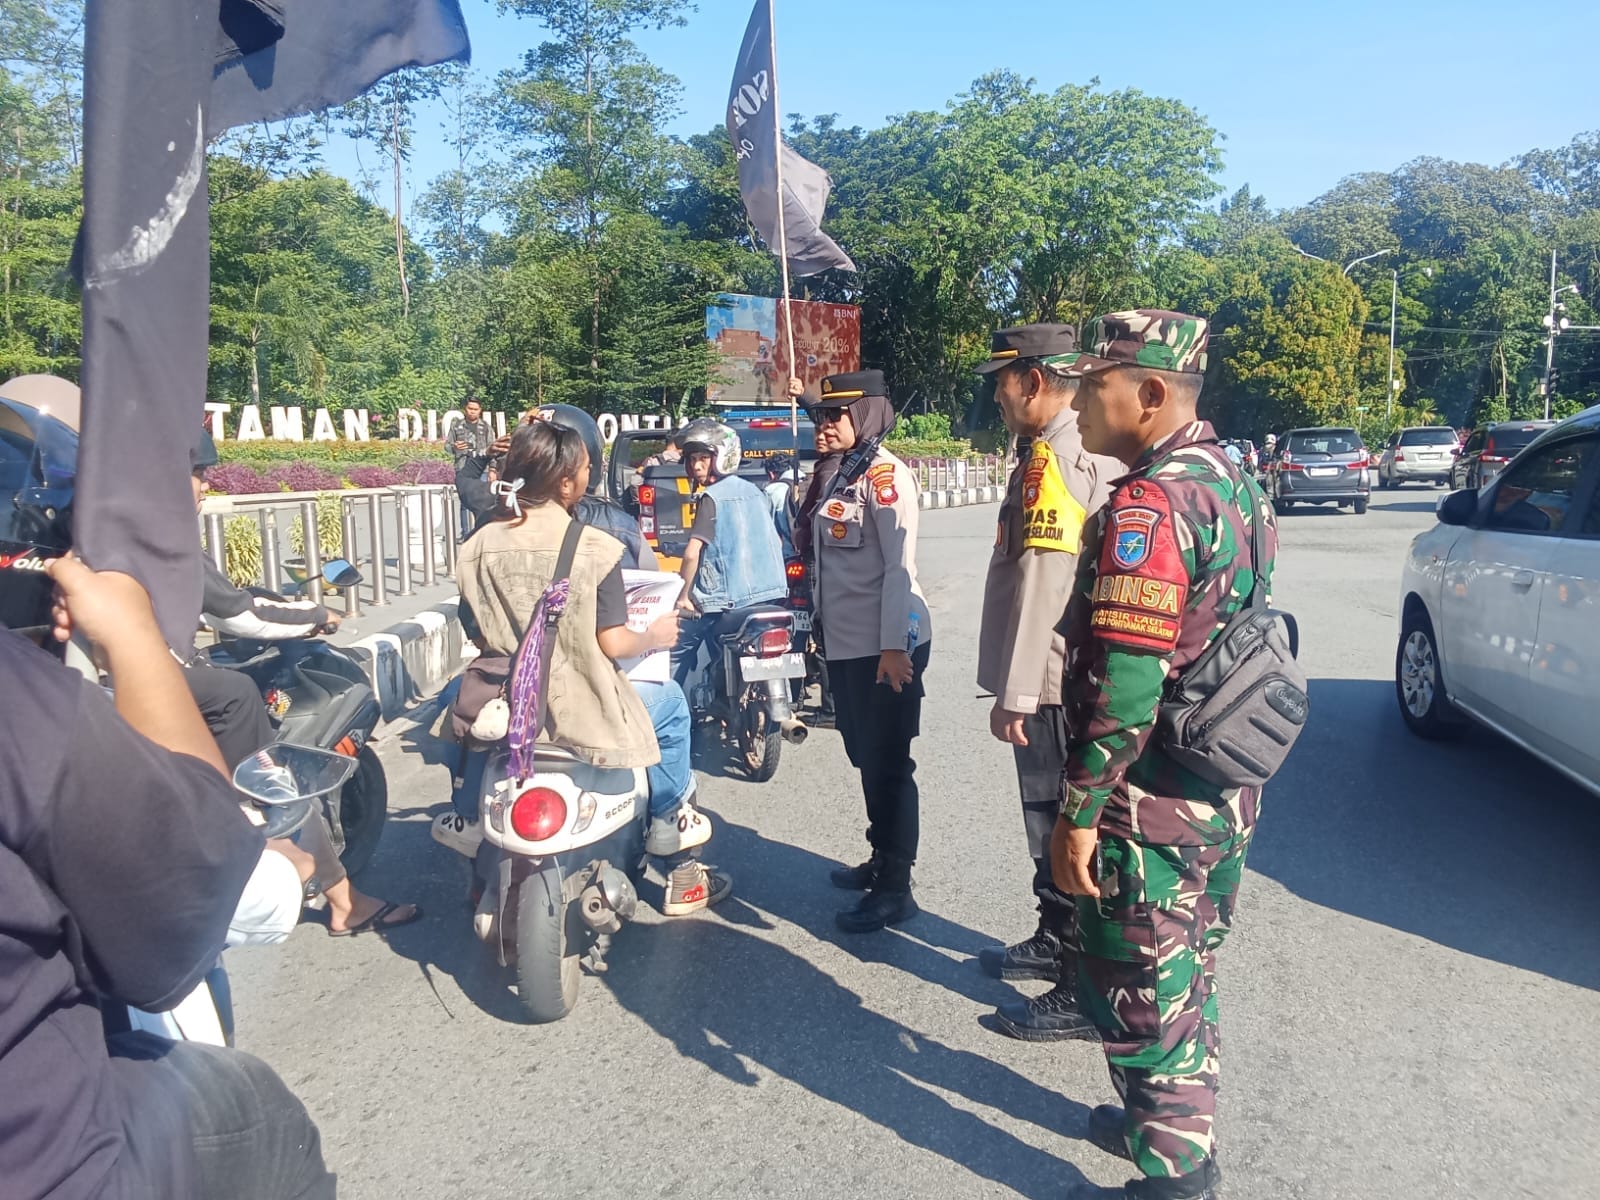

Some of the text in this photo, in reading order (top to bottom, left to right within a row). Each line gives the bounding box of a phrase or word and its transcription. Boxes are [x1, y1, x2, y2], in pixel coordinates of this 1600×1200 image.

[823, 336, 850, 354] 20%
[204, 402, 372, 441] TAMAN
[743, 450, 763, 458] CALL
[1134, 614, 1164, 627] LAUT
